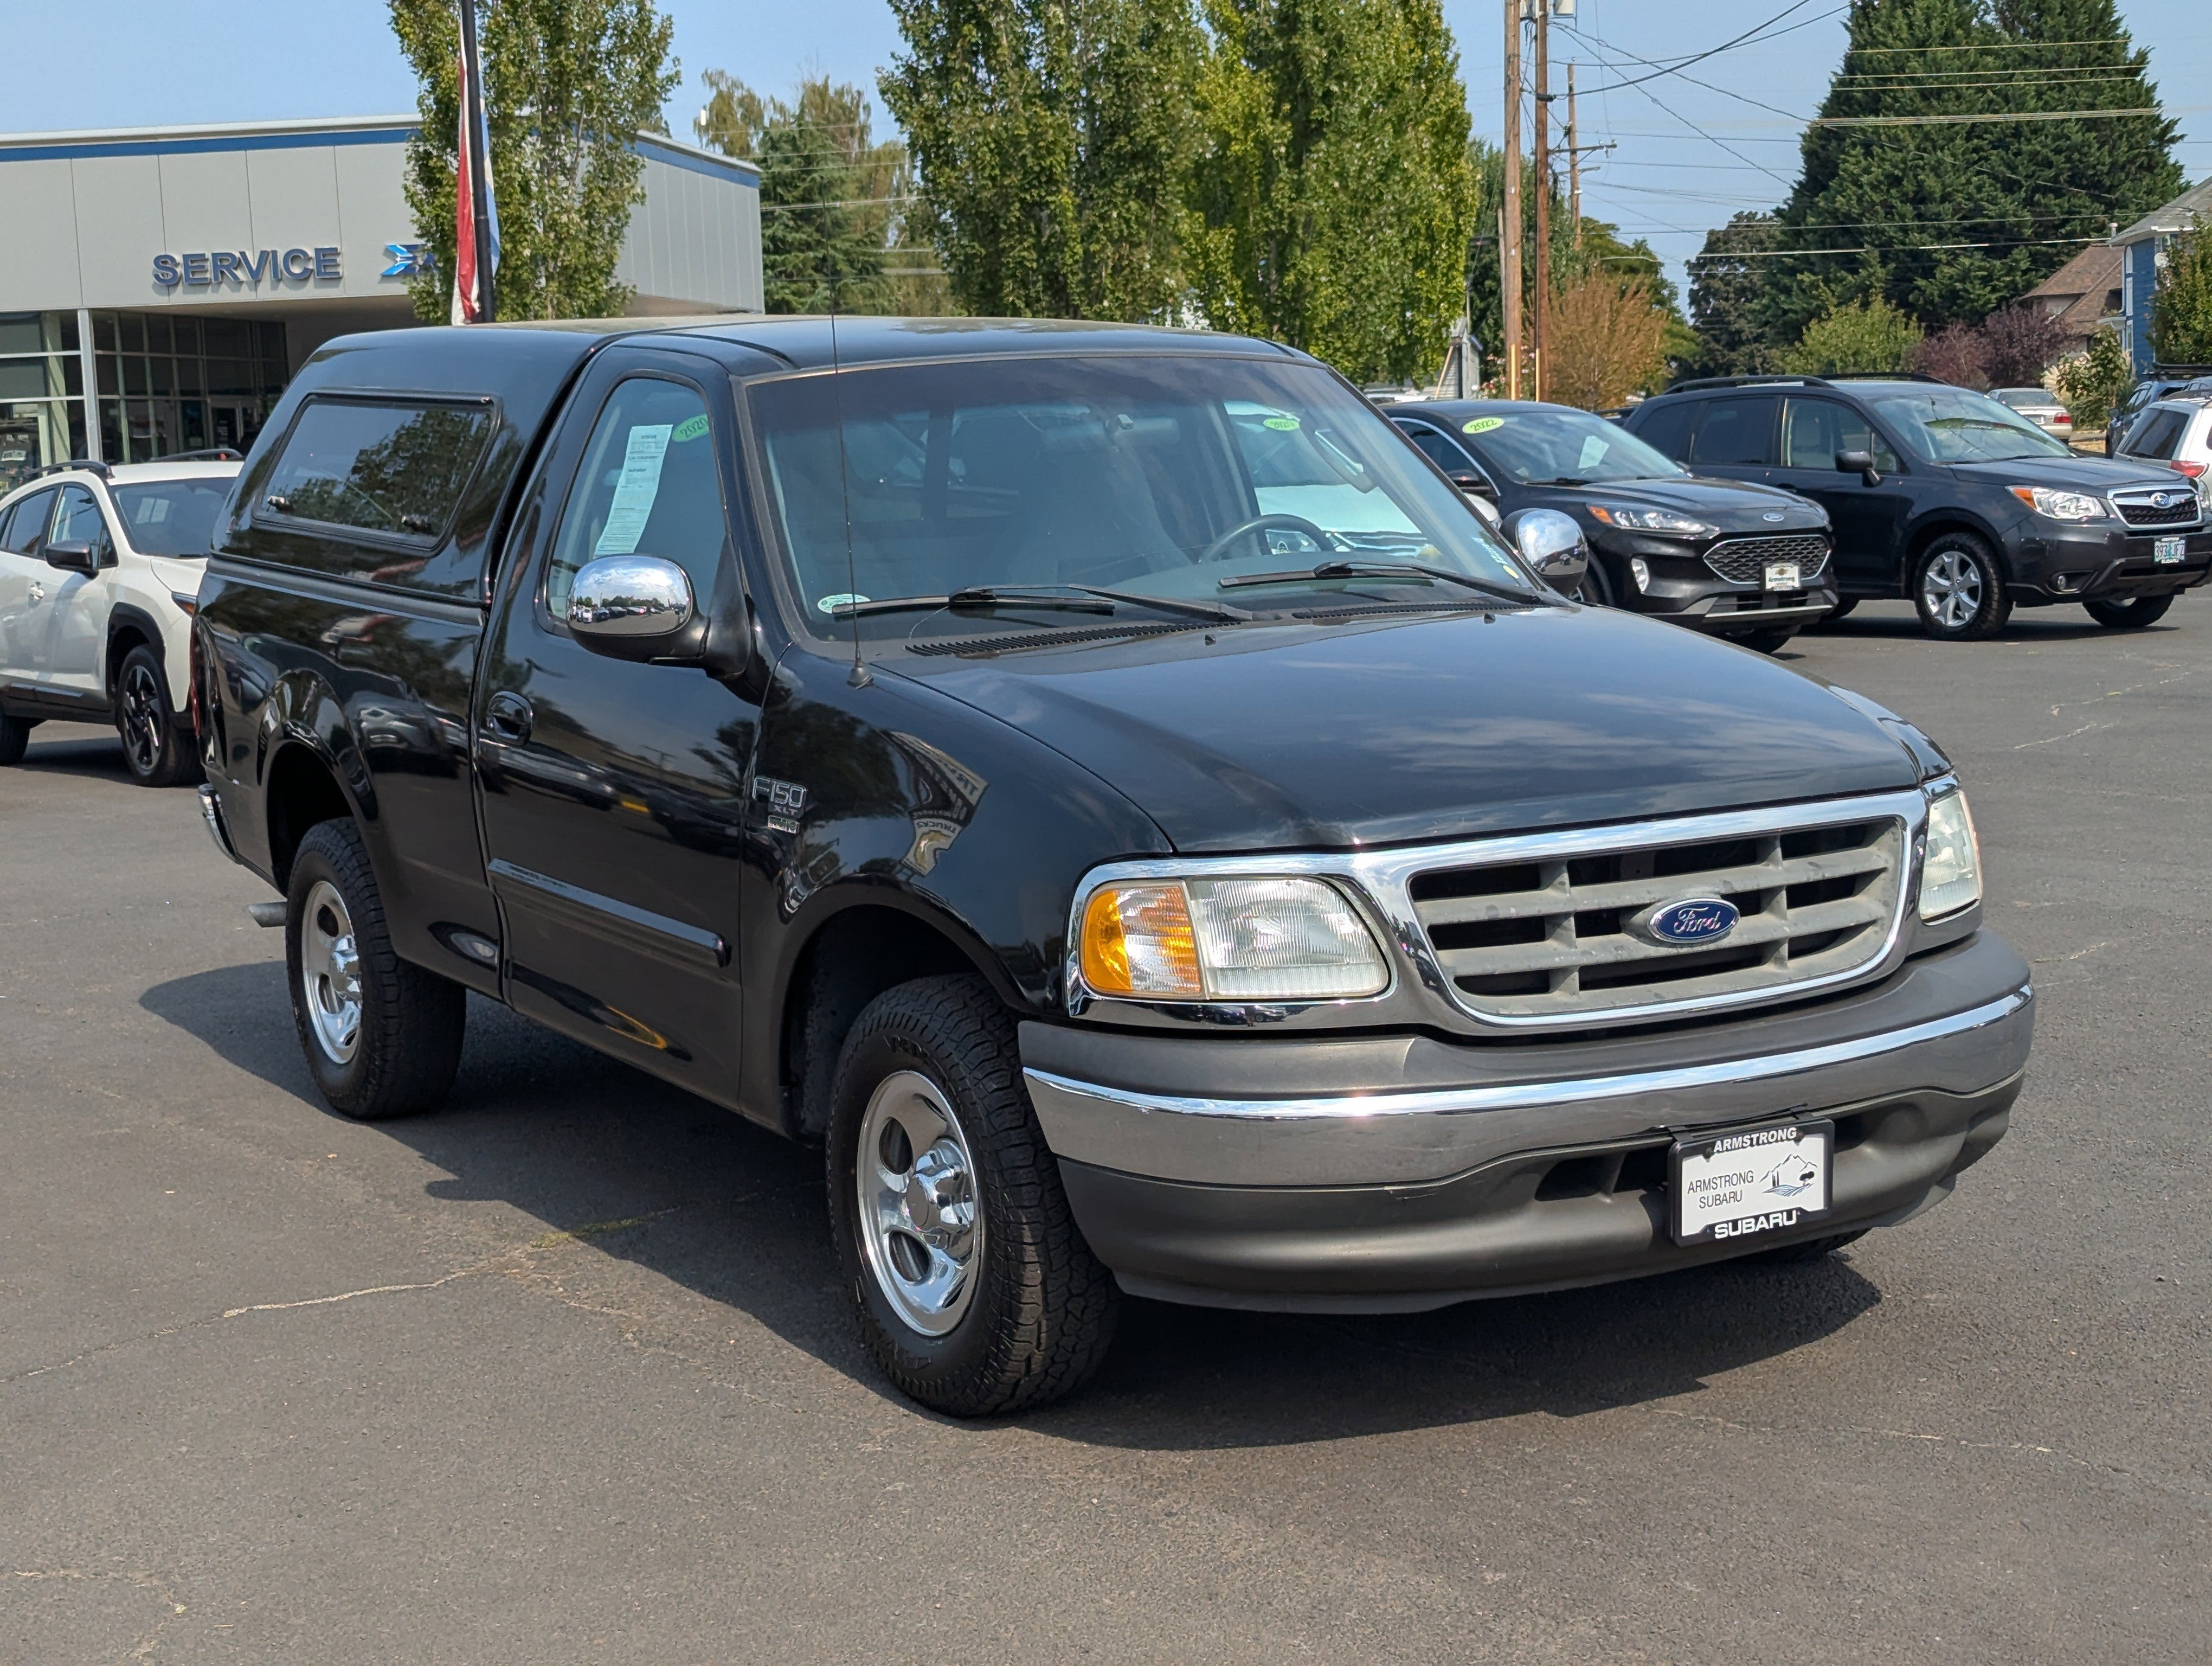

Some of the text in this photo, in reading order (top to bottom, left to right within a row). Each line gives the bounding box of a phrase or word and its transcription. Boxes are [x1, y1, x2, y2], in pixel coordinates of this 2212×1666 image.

[153, 247, 342, 285] SERVICE
[1470, 419, 1497, 432] 2022
[773, 805, 798, 816] XLT
[1674, 906, 1721, 934] Ford
[1713, 1127, 1797, 1152] ARMSTRONG
[1687, 1170, 1754, 1194] ARMSTRONG
[1699, 1189, 1743, 1209] SUBARU
[1714, 1209, 1797, 1239] SUBARU
